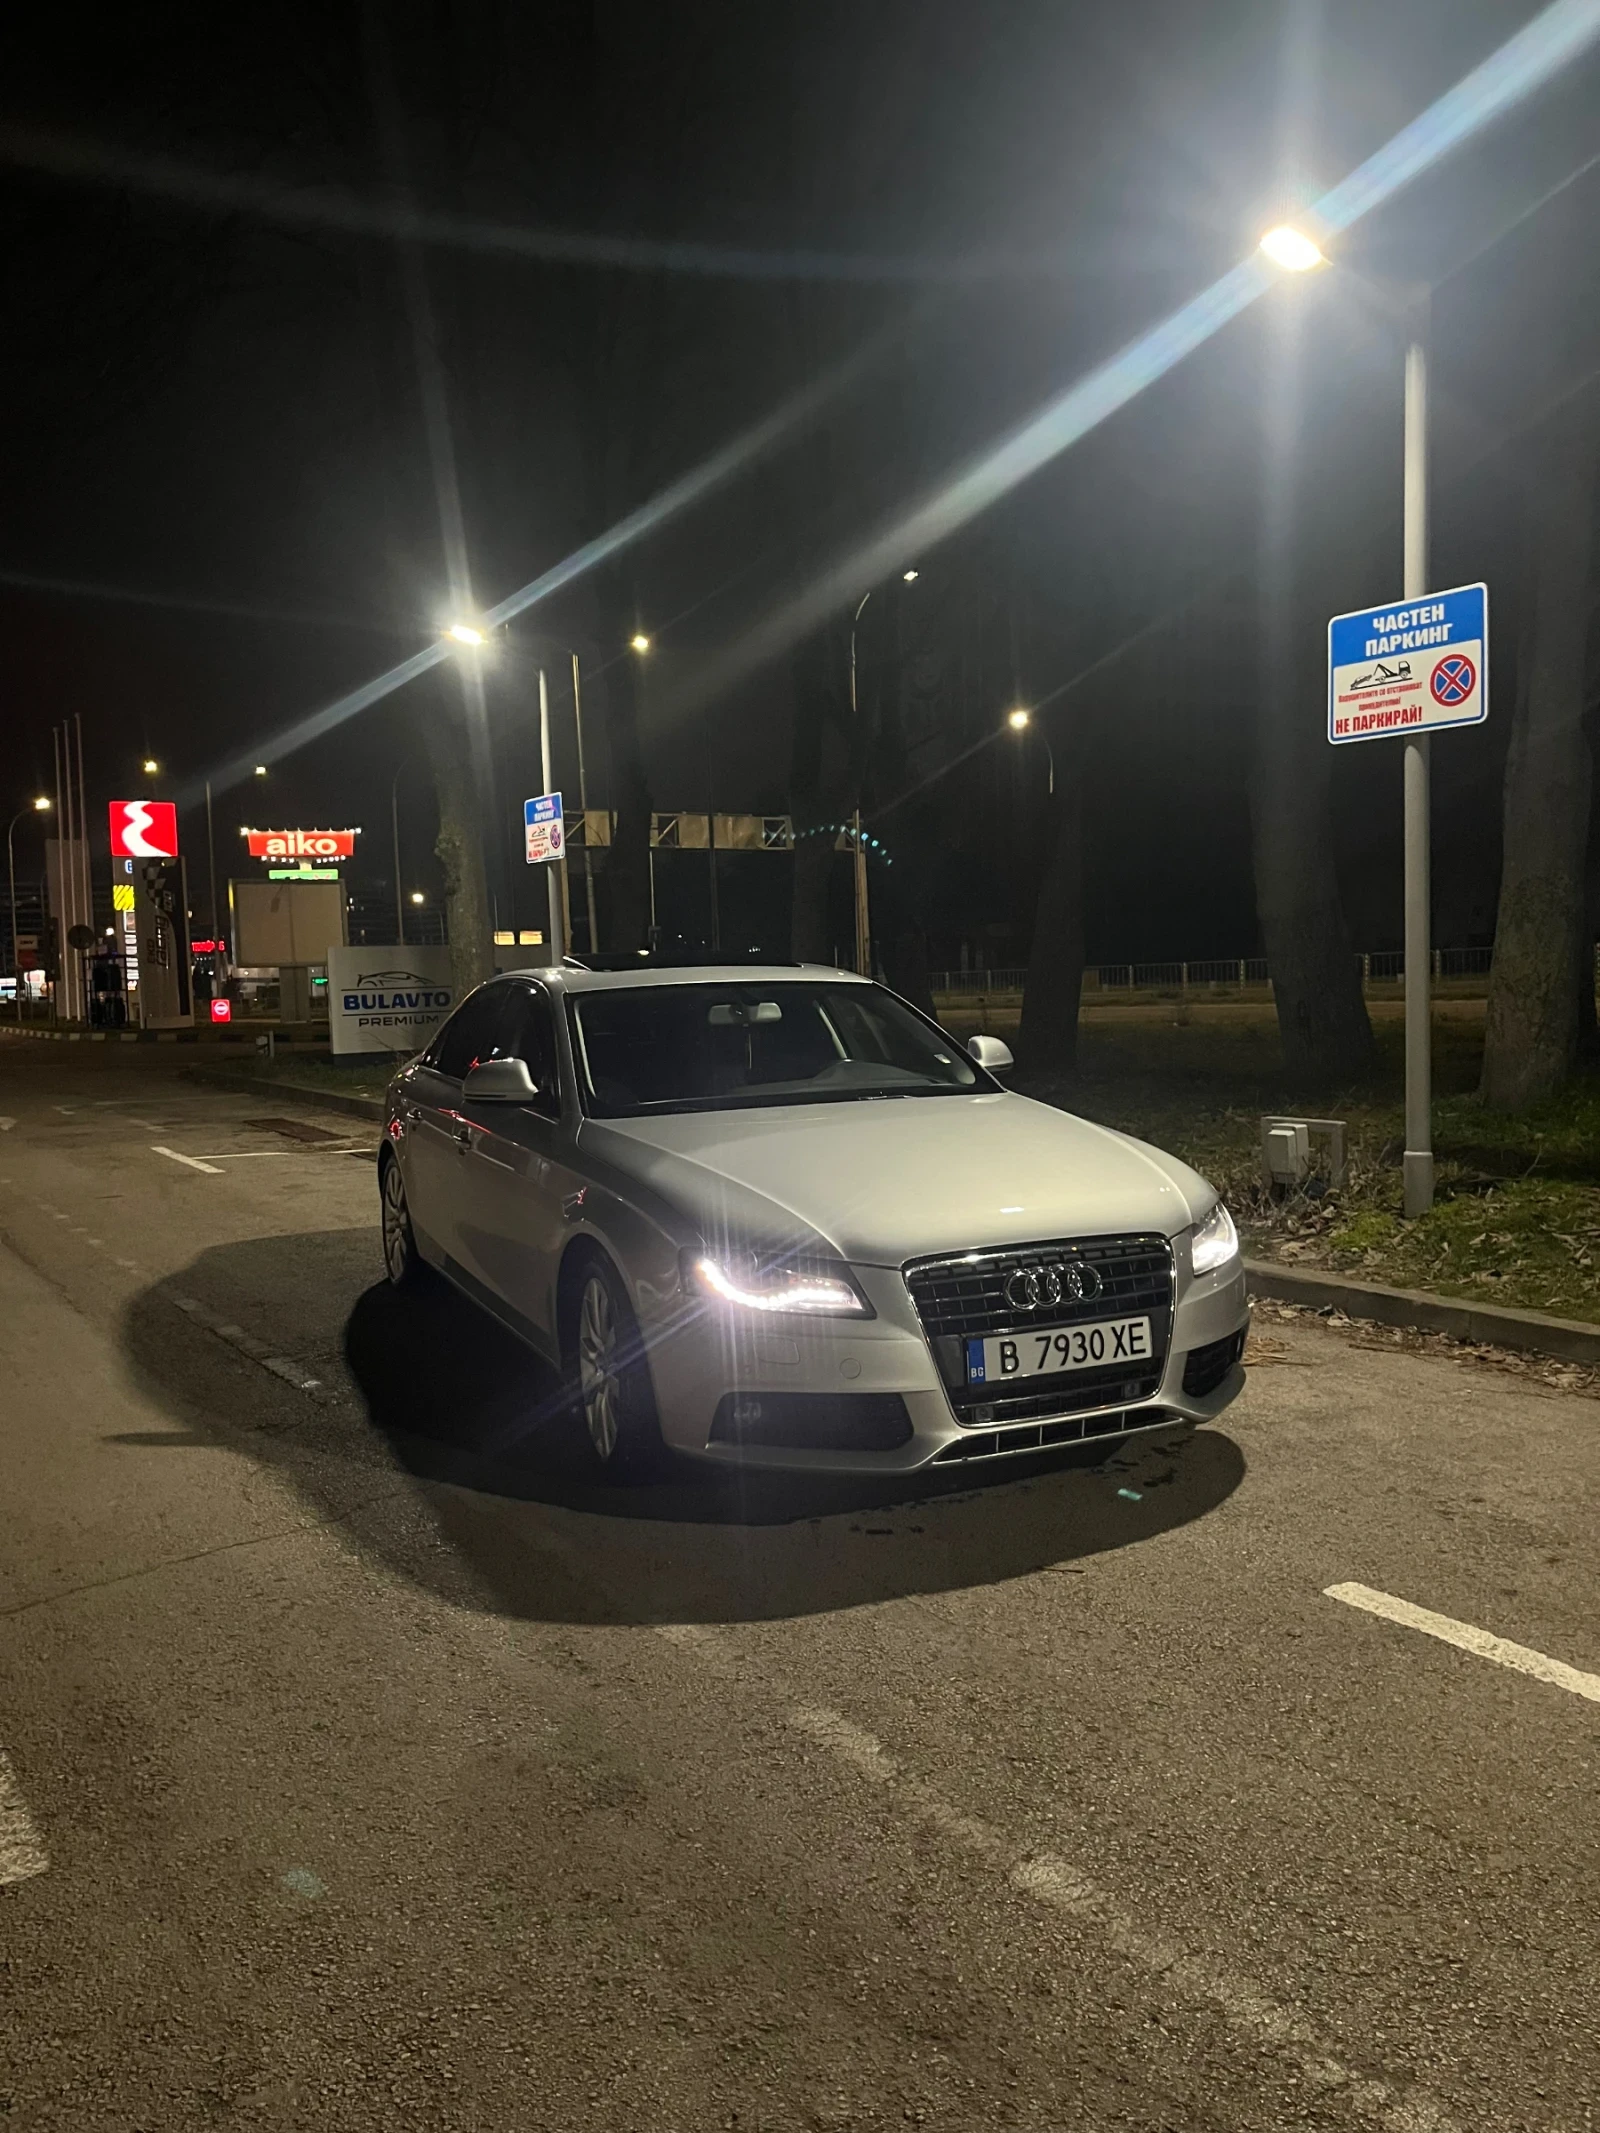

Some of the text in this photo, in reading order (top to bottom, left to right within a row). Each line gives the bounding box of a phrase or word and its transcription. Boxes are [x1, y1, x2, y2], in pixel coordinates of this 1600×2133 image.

[1373, 603, 1444, 633] ЧАСТЕН
[1365, 623, 1453, 657] ПАРКИНГ
[1335, 704, 1423, 734] НЕ ПАРКИРАЙ!
[266, 833, 338, 855] aiko
[343, 991, 451, 1011] BULAVTO
[358, 1015, 439, 1027] PREMIUM
[1000, 1322, 1147, 1374] B 7930 XE
[971, 1366, 984, 1378] BG
